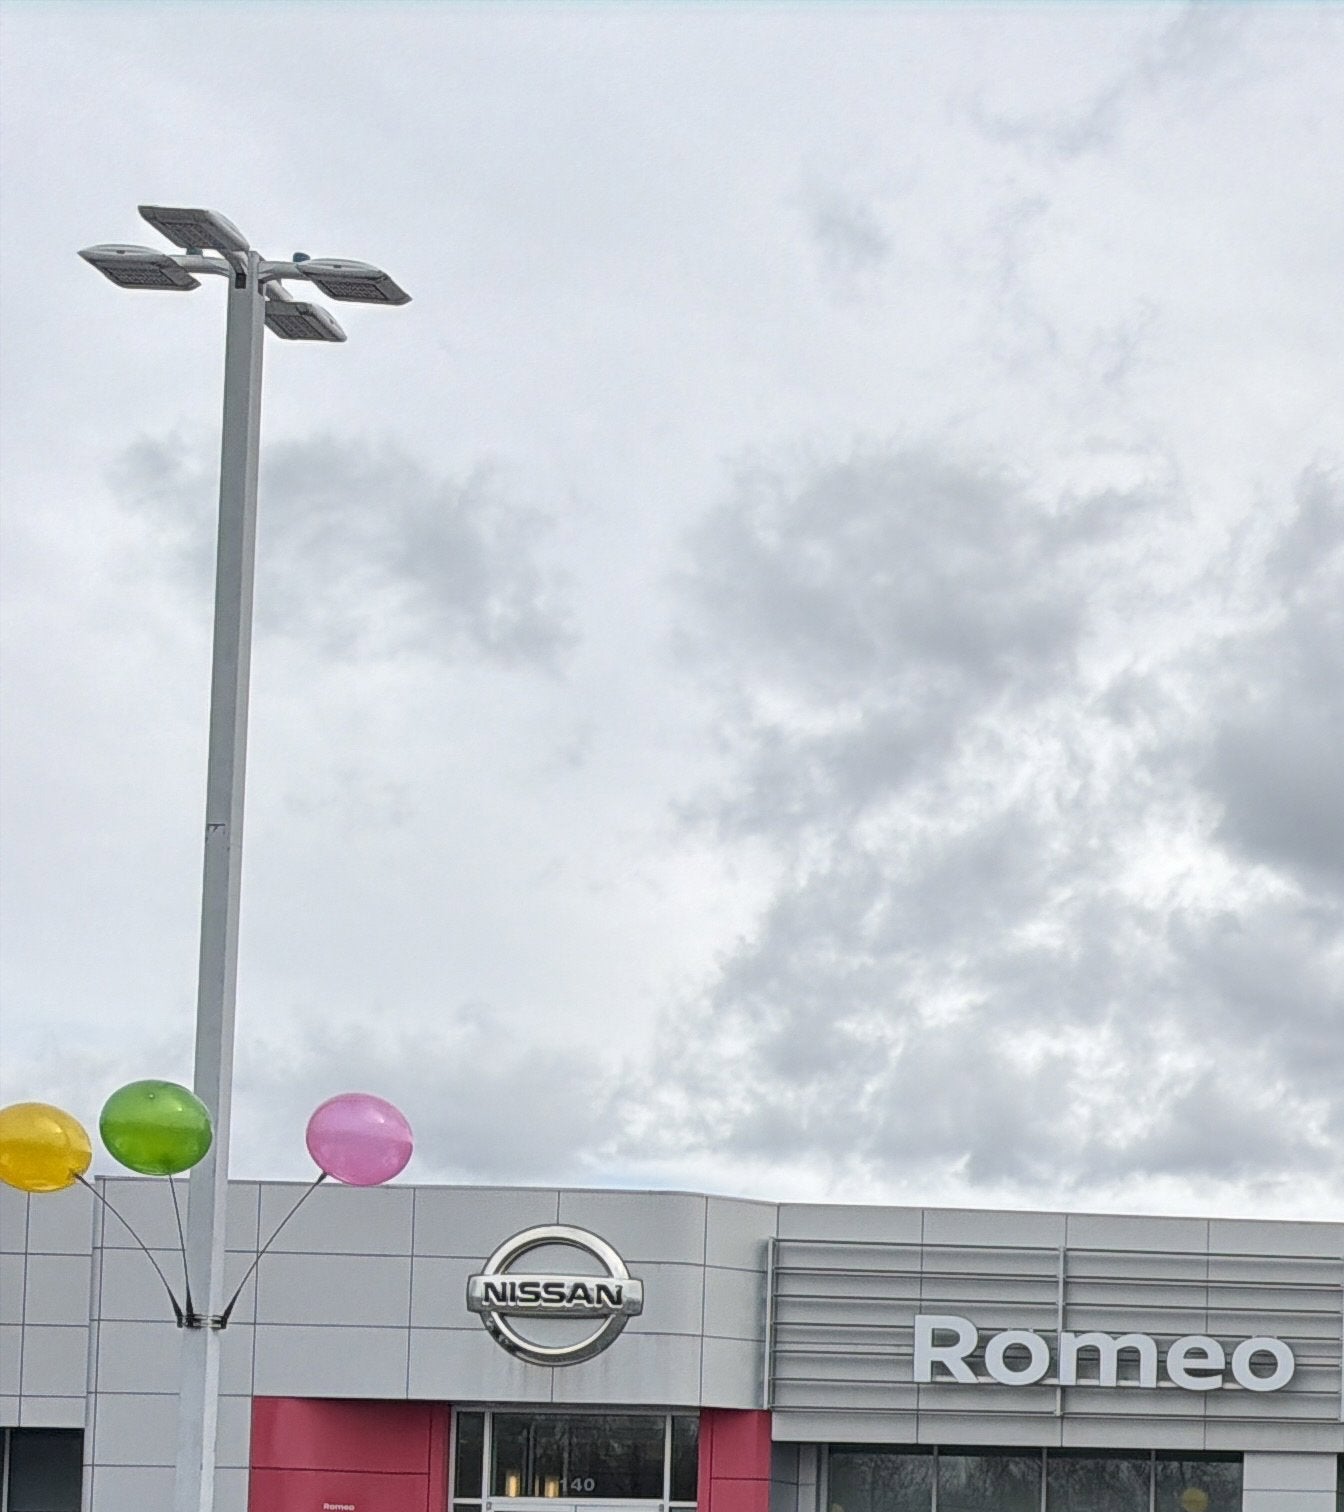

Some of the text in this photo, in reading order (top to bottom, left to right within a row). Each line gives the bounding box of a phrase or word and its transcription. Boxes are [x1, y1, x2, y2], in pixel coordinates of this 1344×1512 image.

[482, 1281, 623, 1307] NISSAN
[914, 1315, 1295, 1393] Romeo
[560, 1478, 595, 1492] 140
[323, 1503, 355, 1511] Romeo
